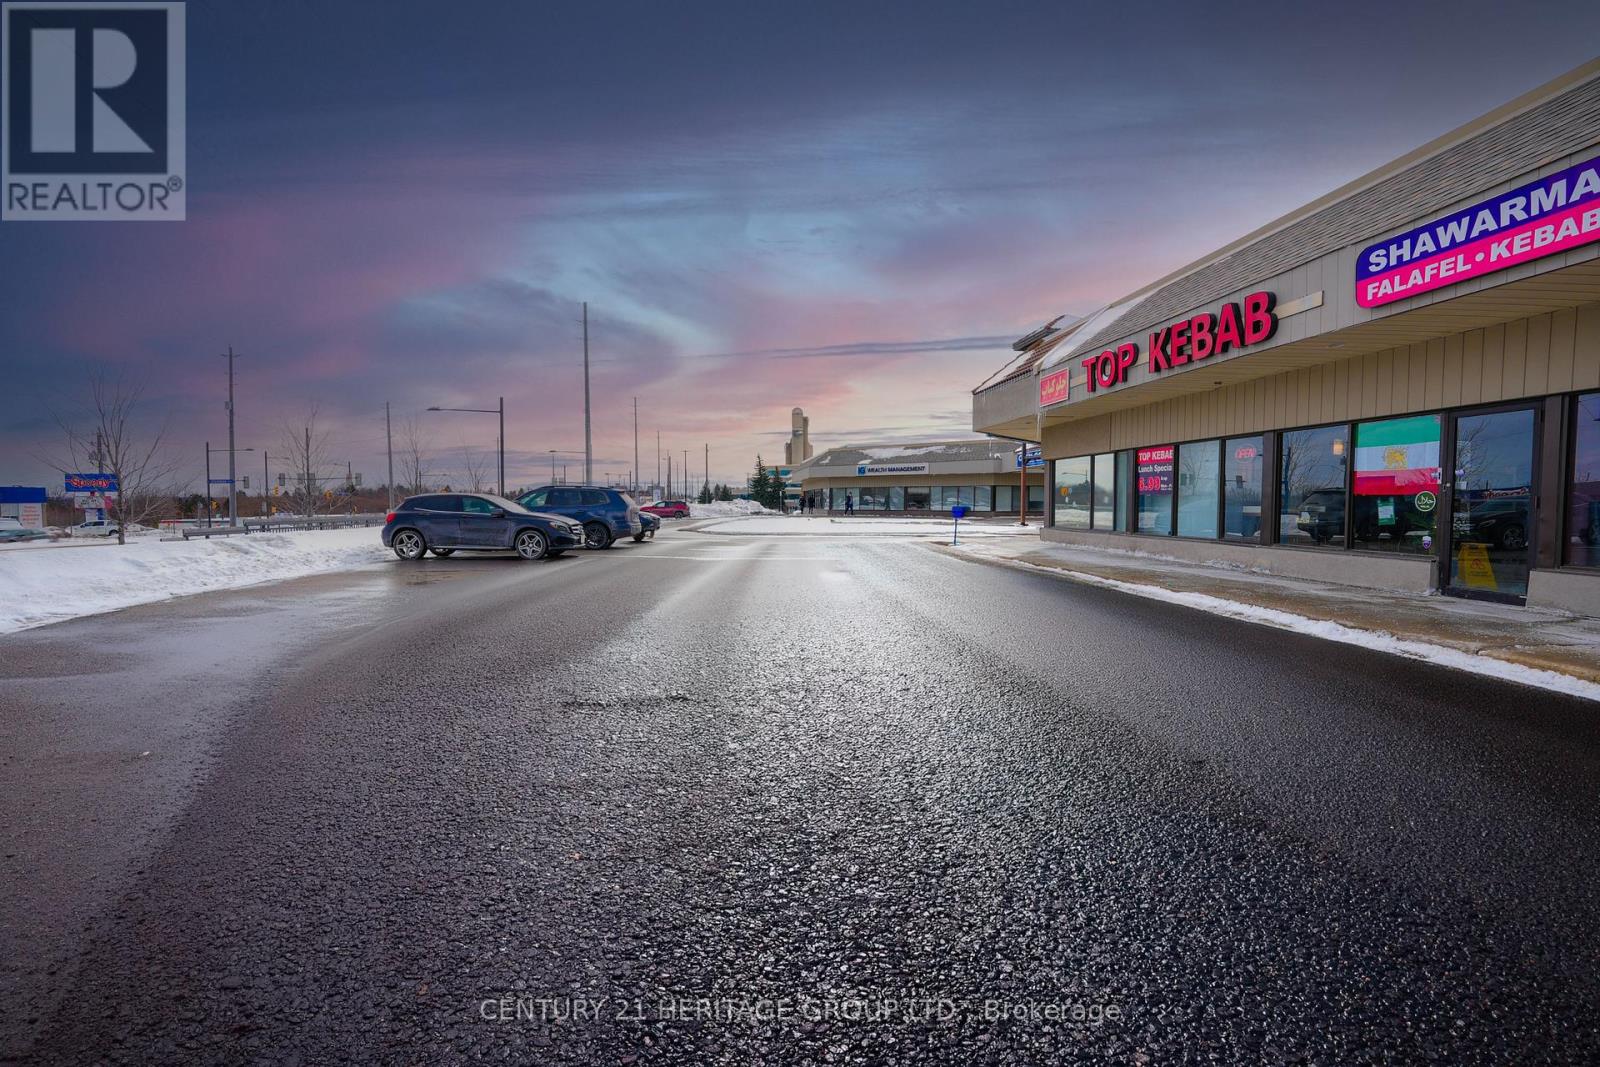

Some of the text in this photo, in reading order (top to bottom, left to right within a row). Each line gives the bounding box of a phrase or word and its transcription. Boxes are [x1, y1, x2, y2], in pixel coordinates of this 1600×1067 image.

[1368, 168, 1600, 273] SHAWARMA
[1367, 209, 1600, 301] FALAFEL KEBAB
[1082, 291, 1279, 393] TOP KEBAB
[888, 465, 926, 473] MANAGEMENT
[1138, 463, 1173, 474] Lunch Specia
[1139, 452, 1151, 461] TOP
